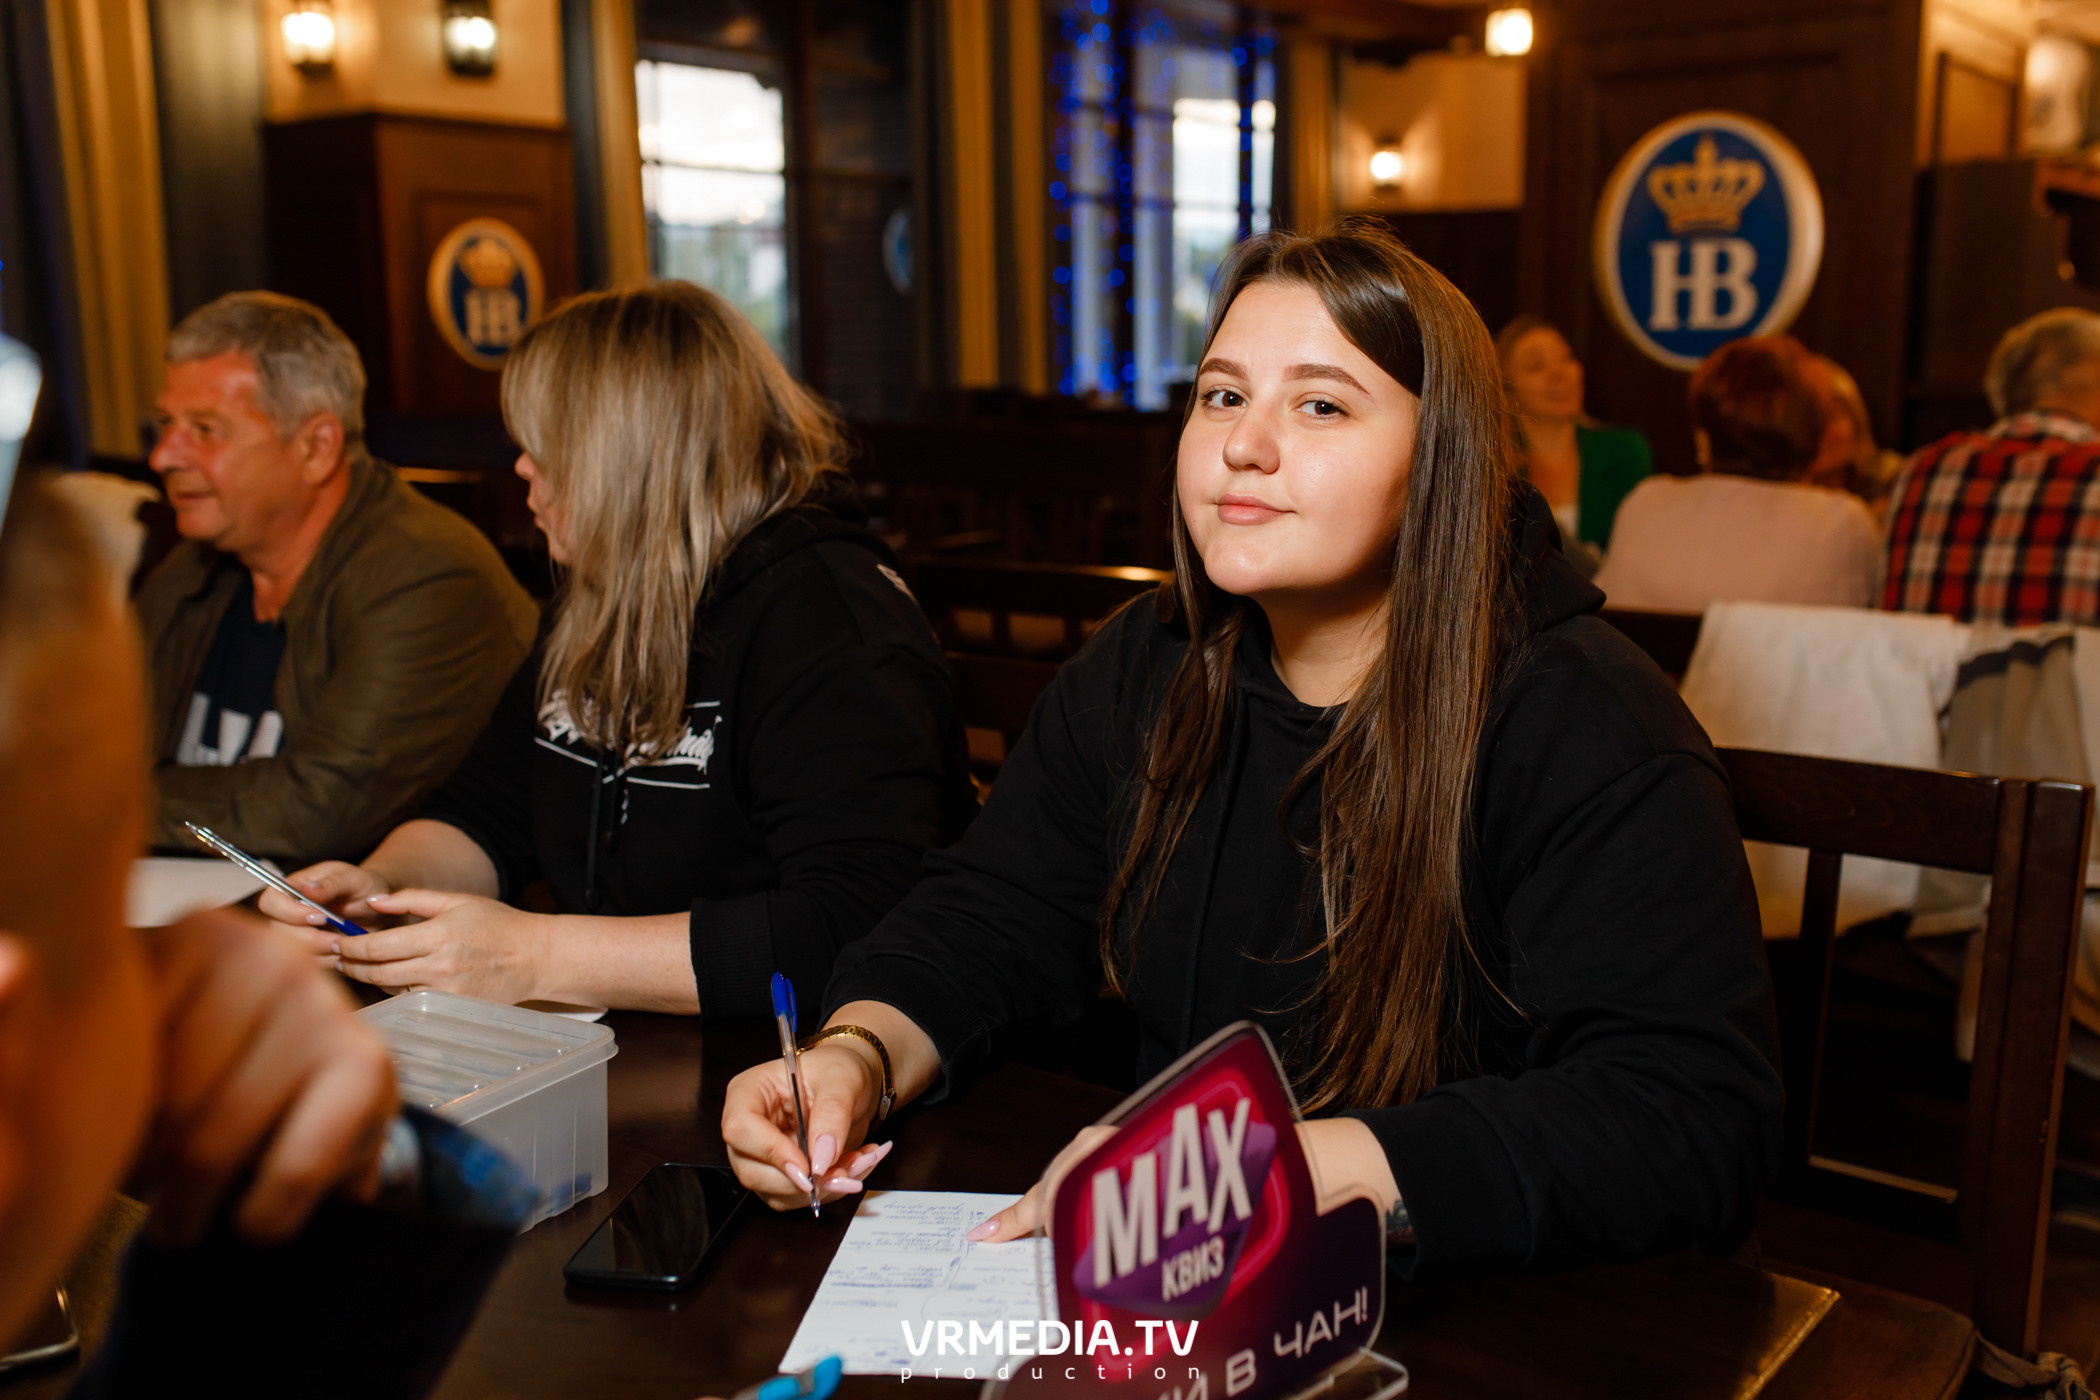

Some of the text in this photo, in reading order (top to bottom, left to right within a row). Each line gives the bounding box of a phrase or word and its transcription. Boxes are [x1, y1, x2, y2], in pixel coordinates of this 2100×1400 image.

[1649, 238, 1758, 331] HB
[1091, 1097, 1253, 1288] MAX
[1161, 1235, 1226, 1302] КВИЗ
[1226, 1347, 1257, 1398] В
[1273, 1285, 1368, 1358] ЧАН!
